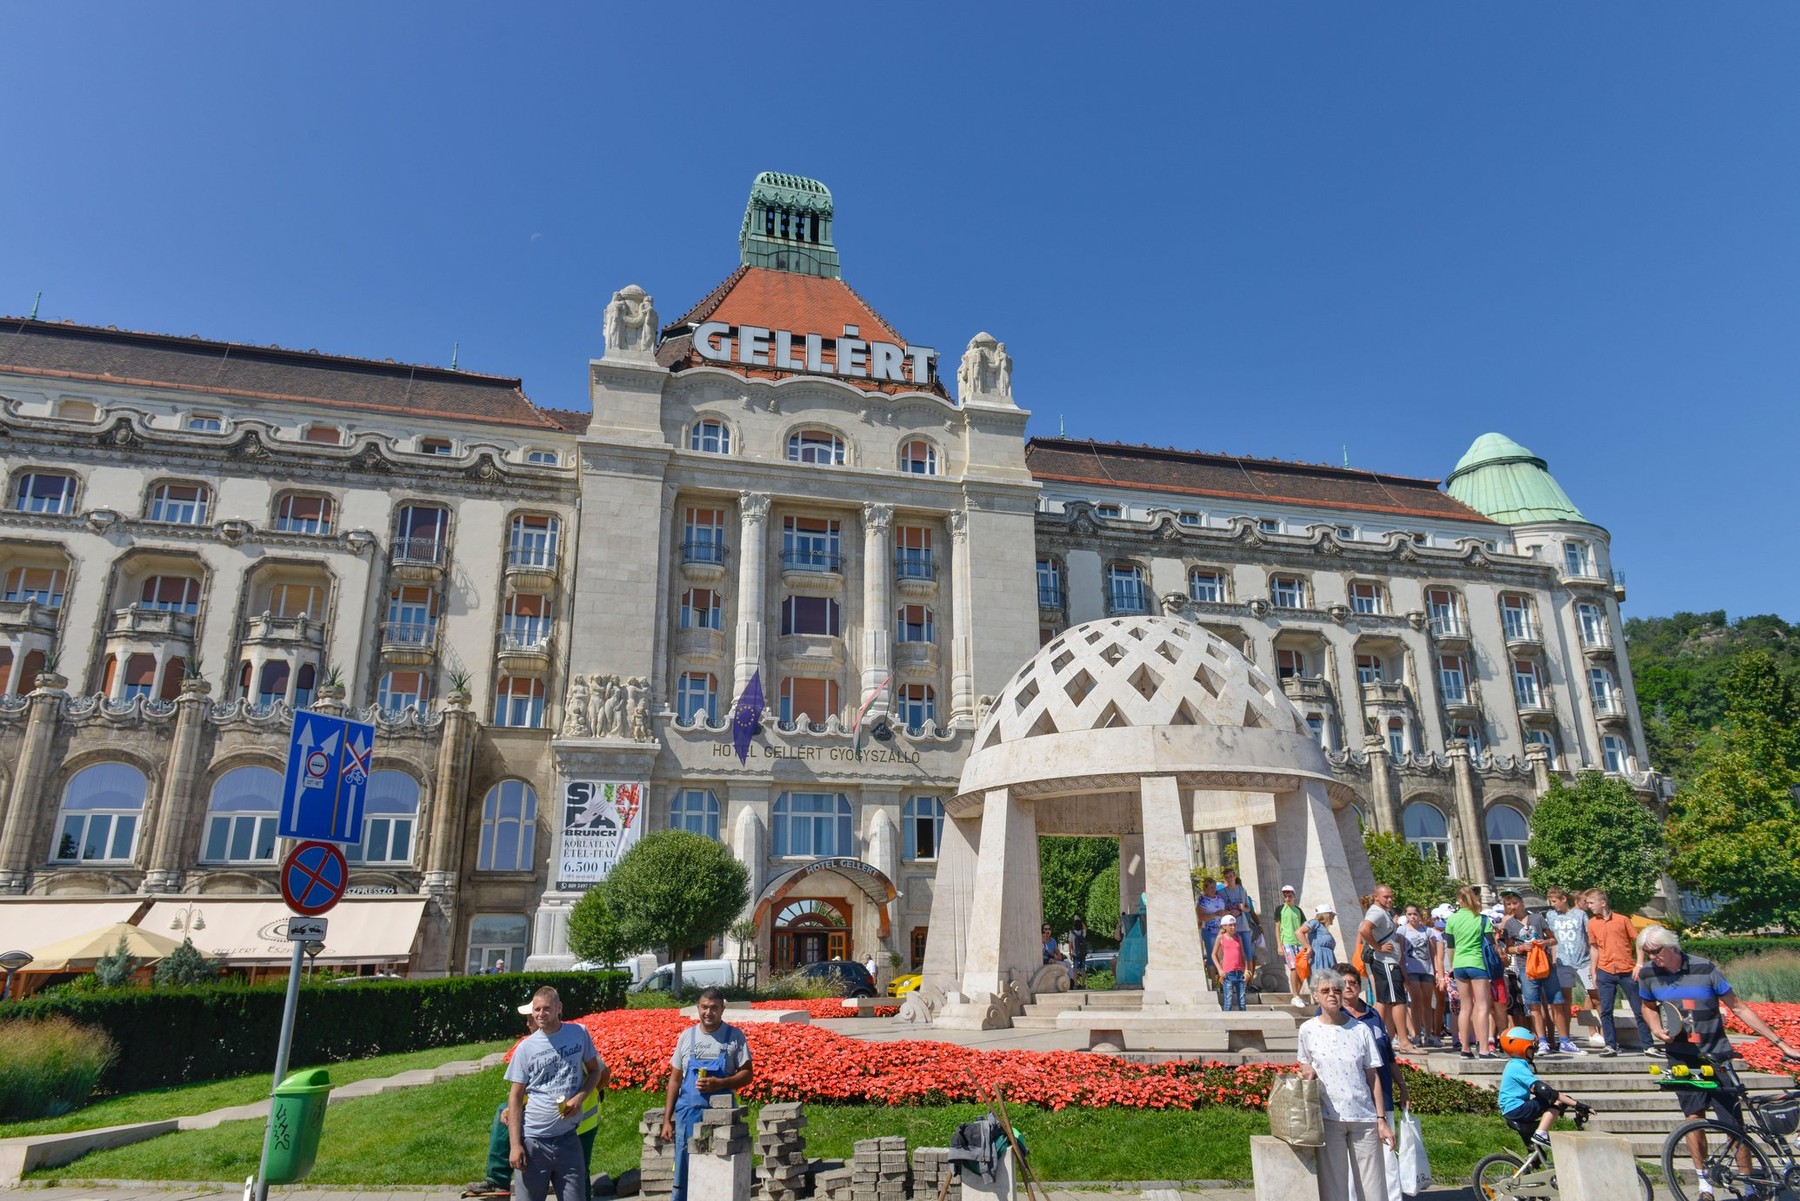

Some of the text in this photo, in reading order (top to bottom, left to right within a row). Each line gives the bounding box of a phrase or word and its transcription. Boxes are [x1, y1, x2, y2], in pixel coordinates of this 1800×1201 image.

[693, 321, 935, 384] GELLÉRT
[713, 744, 756, 758] HOL
[764, 745, 823, 760] GELLÉRT
[564, 861, 598, 873] 6.500
[806, 860, 837, 875] HOTEL
[1554, 919, 1579, 930] JUST
[1558, 929, 1576, 940] DO
[558, 1043, 582, 1061] Trade
